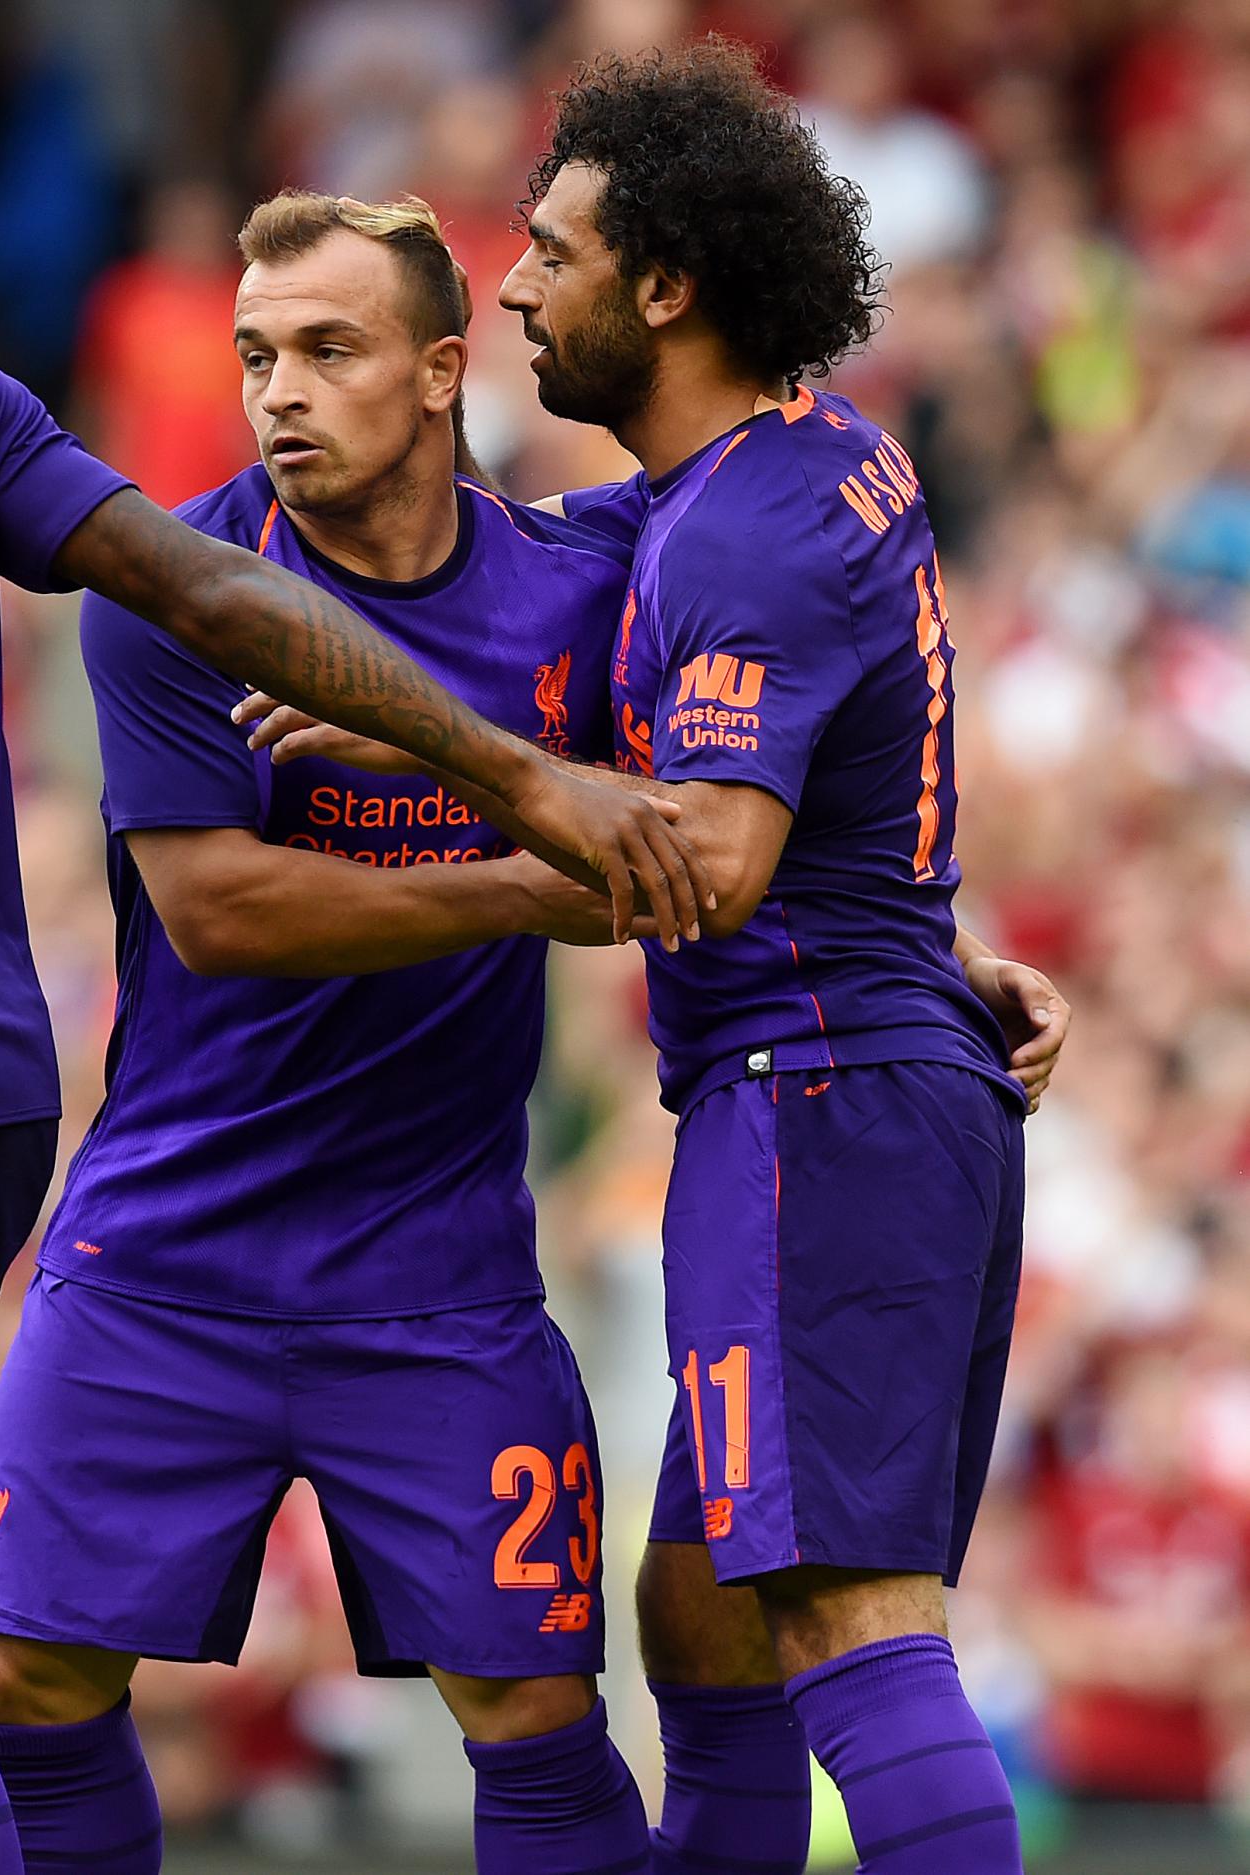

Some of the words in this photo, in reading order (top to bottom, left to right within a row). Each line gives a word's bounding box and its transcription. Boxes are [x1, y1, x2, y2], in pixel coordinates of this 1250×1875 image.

[668, 704, 760, 733] Western
[682, 726, 758, 751] Union
[682, 1345, 750, 1493] 11
[491, 1442, 598, 1588] 23
